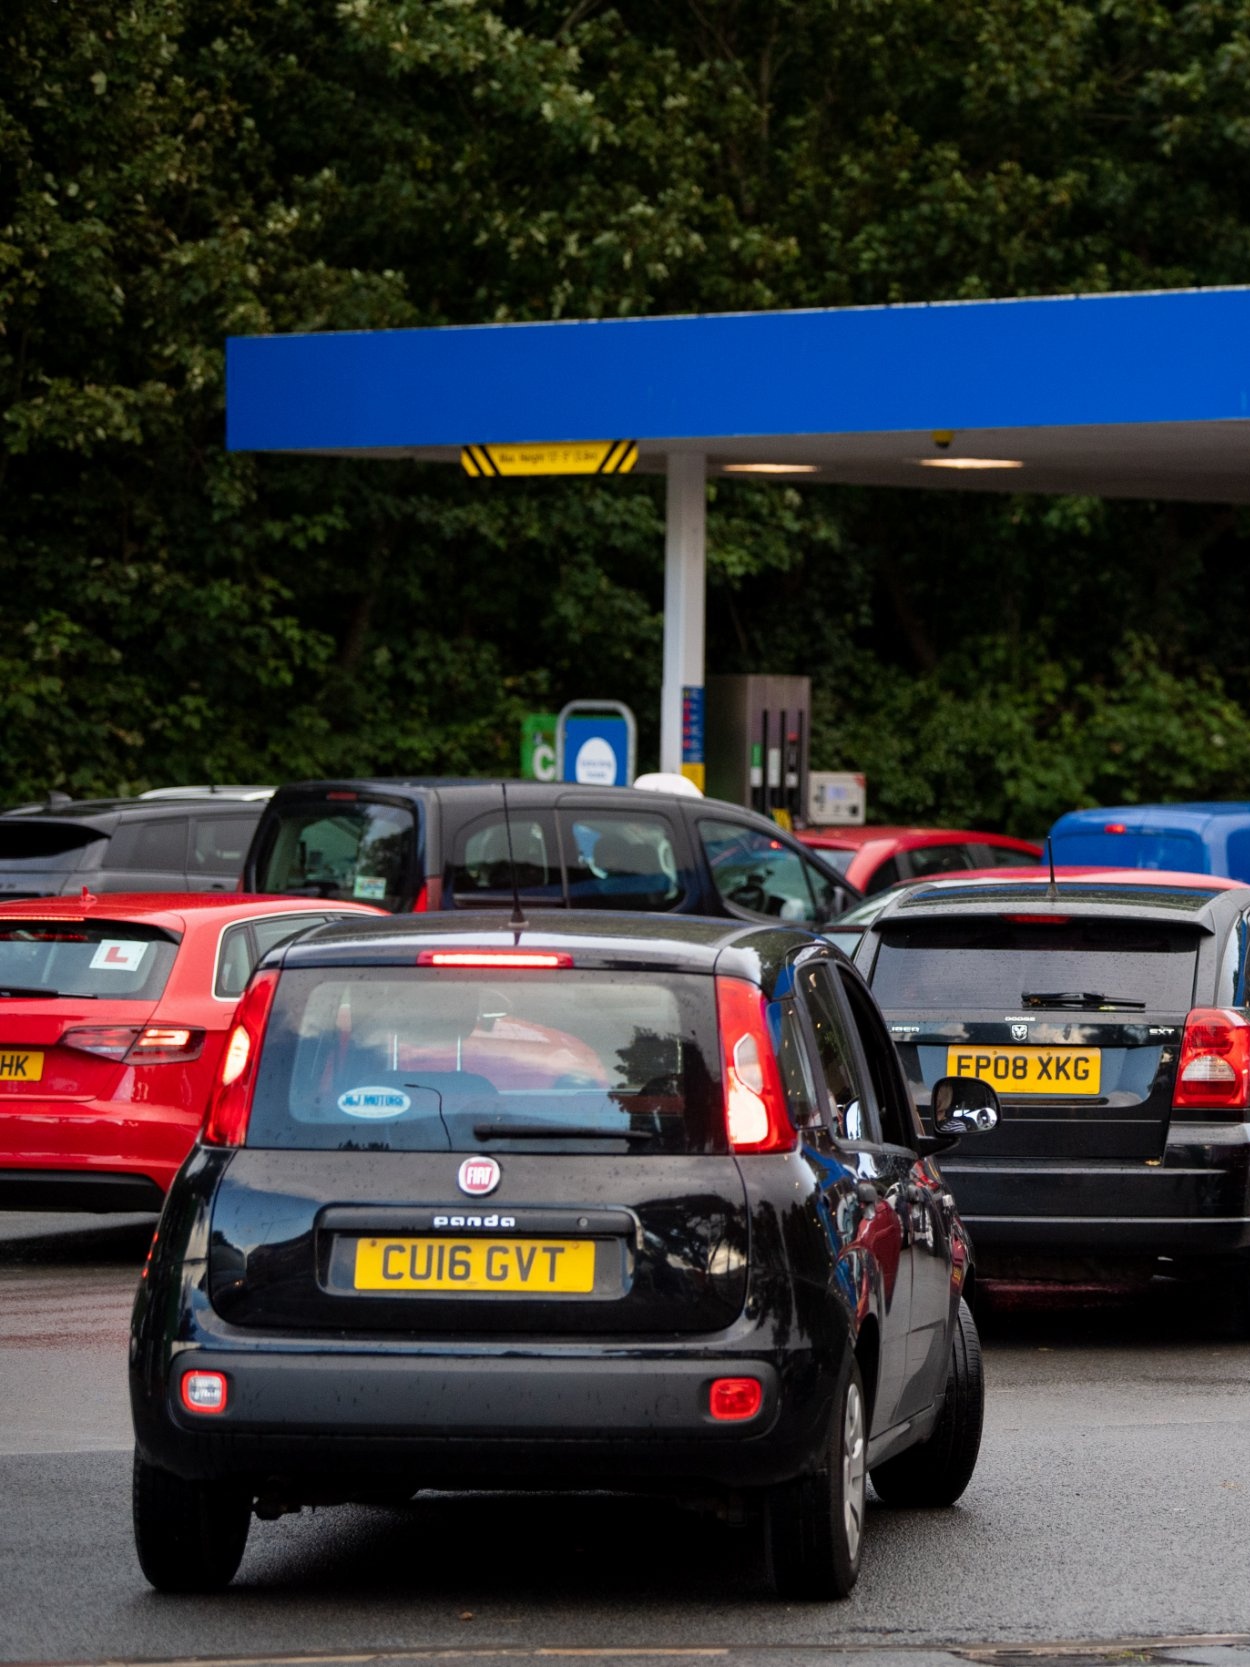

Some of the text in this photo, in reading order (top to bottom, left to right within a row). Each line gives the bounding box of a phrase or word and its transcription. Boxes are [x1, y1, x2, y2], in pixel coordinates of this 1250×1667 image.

[104, 946, 129, 964] L
[1037, 1056, 1090, 1081] XKG
[466, 1166, 492, 1185] FIAT
[433, 1214, 516, 1228] panda
[382, 1244, 566, 1283] CU16 GVT
